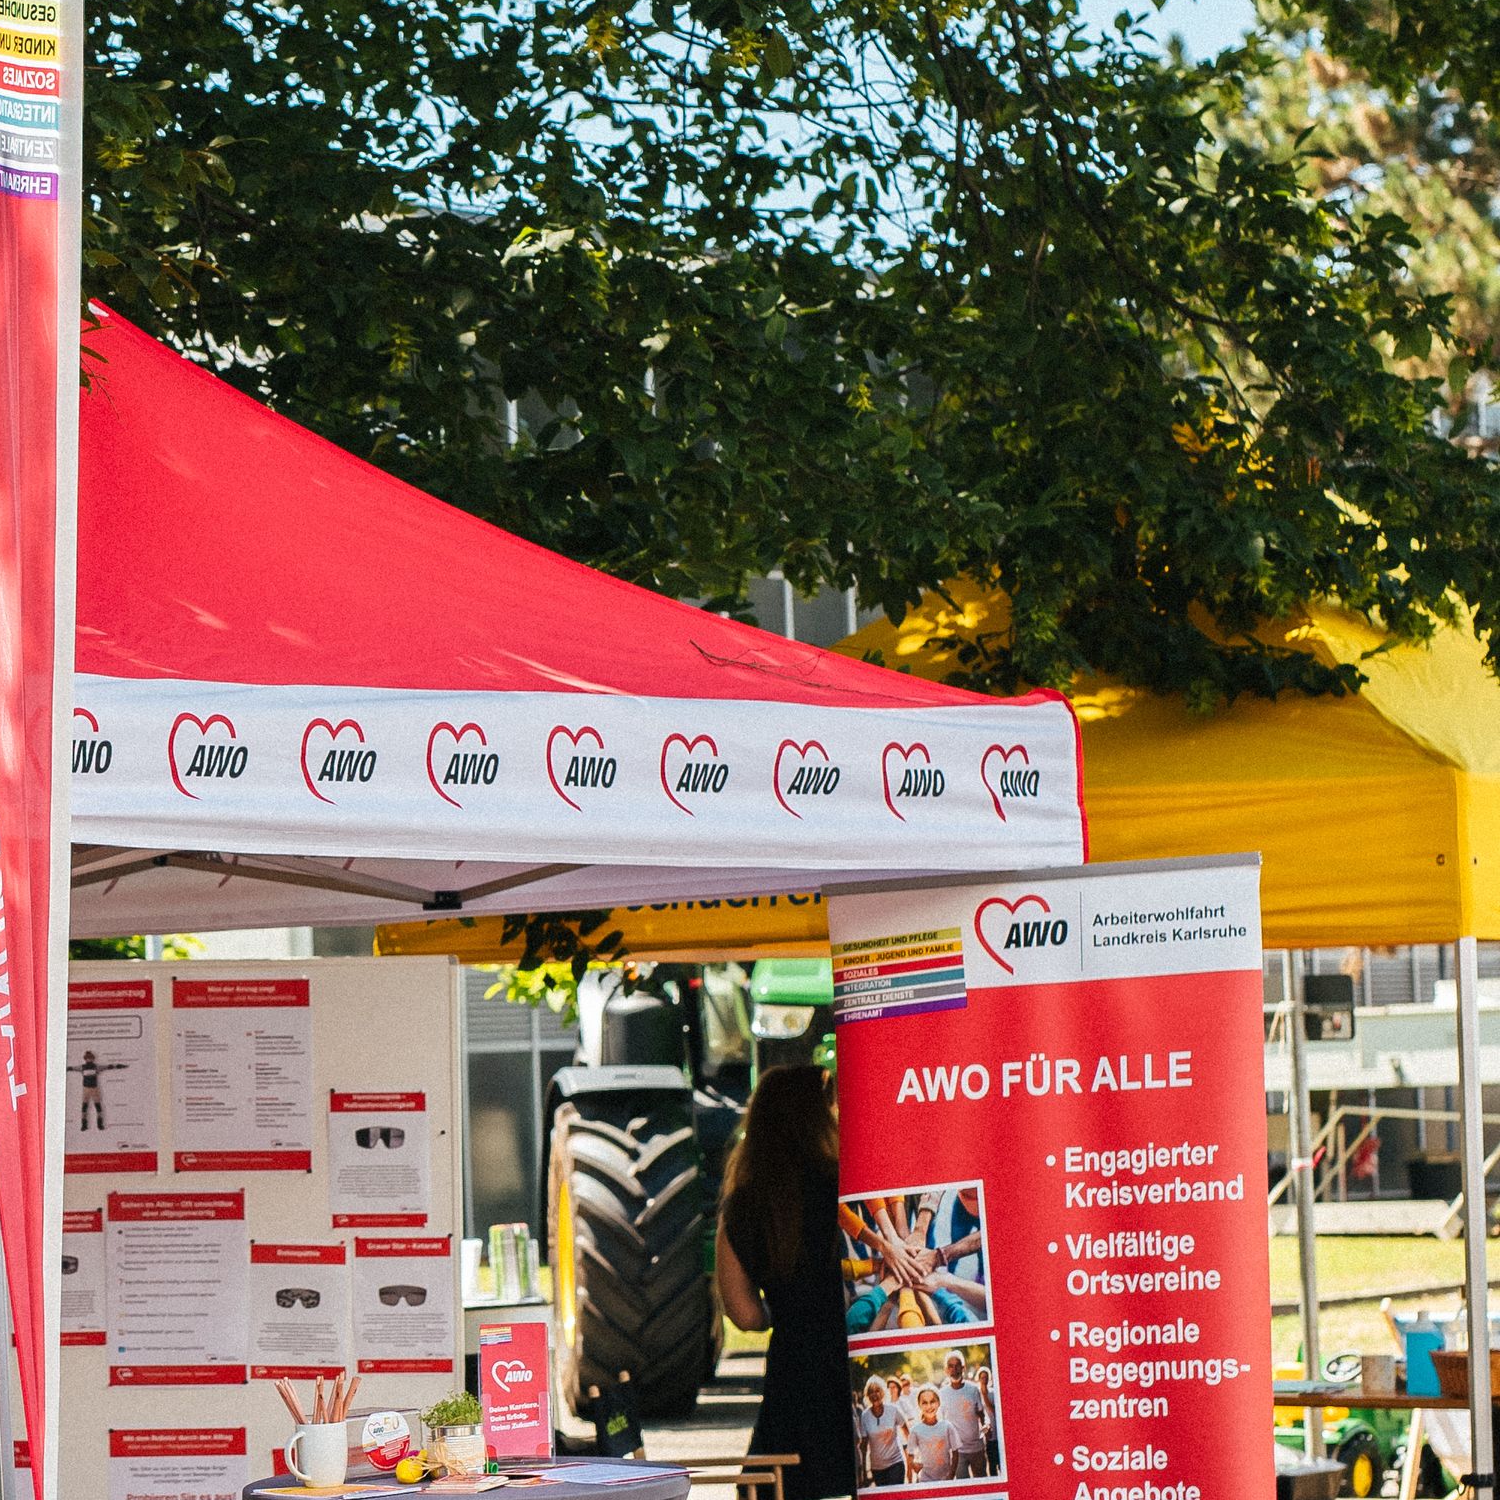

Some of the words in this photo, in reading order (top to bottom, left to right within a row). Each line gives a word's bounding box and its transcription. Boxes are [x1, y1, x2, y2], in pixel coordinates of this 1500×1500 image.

[71, 740, 113, 775] WO
[185, 744, 248, 779] AWO
[318, 749, 377, 783] AWO
[443, 753, 499, 786] AWO
[563, 755, 617, 790] AWO
[676, 763, 729, 795] AWO
[787, 766, 840, 797] AWO
[896, 768, 946, 799] AWO
[1000, 768, 1041, 799] AWO
[1092, 905, 1226, 927] Arbeiterwohlfahrt
[843, 940, 889, 952] GESUNDHEIT
[892, 936, 908, 945] UND
[909, 931, 939, 942] PFLEGE
[1004, 919, 1069, 950] AWO
[1092, 927, 1167, 948] Landkreis
[1172, 923, 1248, 942] Karlsruhe
[843, 955, 870, 965] KINDER
[876, 951, 906, 961] JUGEND
[908, 947, 924, 957] UND
[925, 943, 954, 954] FAMILIE
[843, 967, 879, 980] SOZIALES
[843, 978, 892, 993] INTEGRATION
[843, 995, 880, 1008] ZENTRALE
[882, 990, 915, 1002] DIENSTE
[844, 1009, 883, 1022] EHRENAMT
[896, 1063, 990, 1104] AWO
[1001, 1053, 1082, 1099] FÜR
[1091, 1050, 1194, 1093] ALLE
[1064, 1141, 1219, 1177] Engagierter
[1065, 1174, 1244, 1208] Kreisverband
[1065, 1231, 1195, 1262] Vielfältige
[1067, 1265, 1221, 1296] Ortsvereine
[1069, 1318, 1200, 1353] Regionale
[504, 1369, 533, 1383] AWO
[1069, 1356, 1251, 1388] Begegnungs-
[1070, 1395, 1168, 1419] zentren
[1072, 1444, 1168, 1472] Soziale
